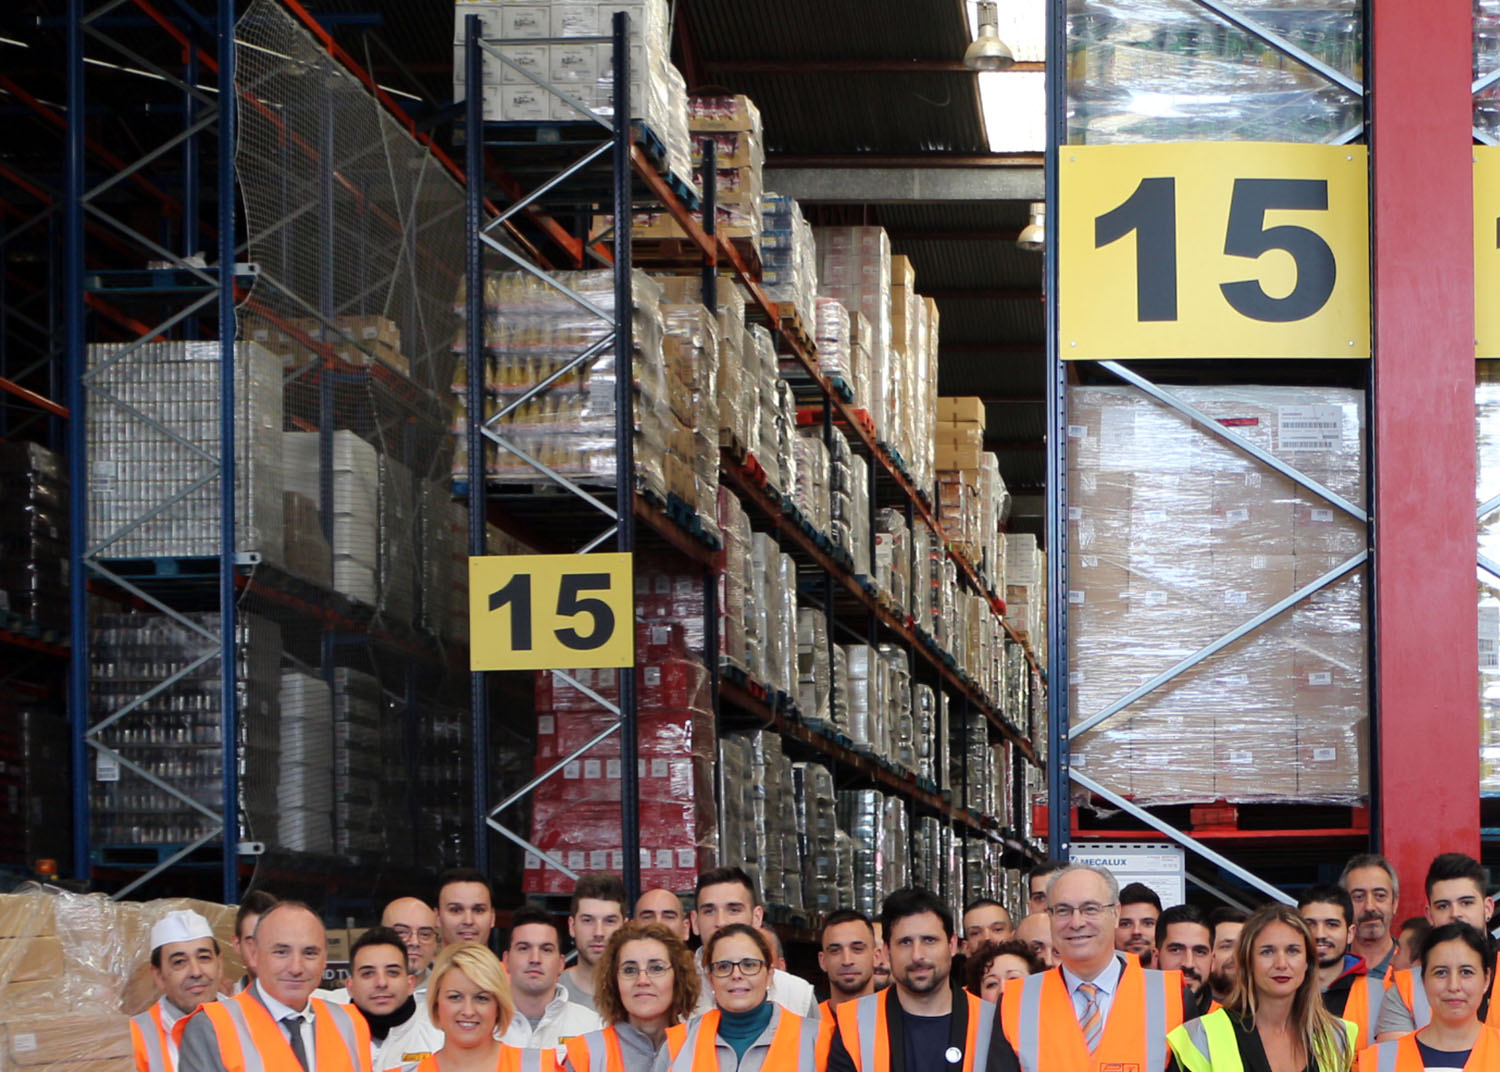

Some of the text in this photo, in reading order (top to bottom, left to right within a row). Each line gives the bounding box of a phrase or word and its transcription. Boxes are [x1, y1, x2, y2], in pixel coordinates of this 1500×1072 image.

[1095, 177, 1336, 322] 15
[489, 573, 616, 651] 15
[1080, 858, 1127, 866] MECALUX
